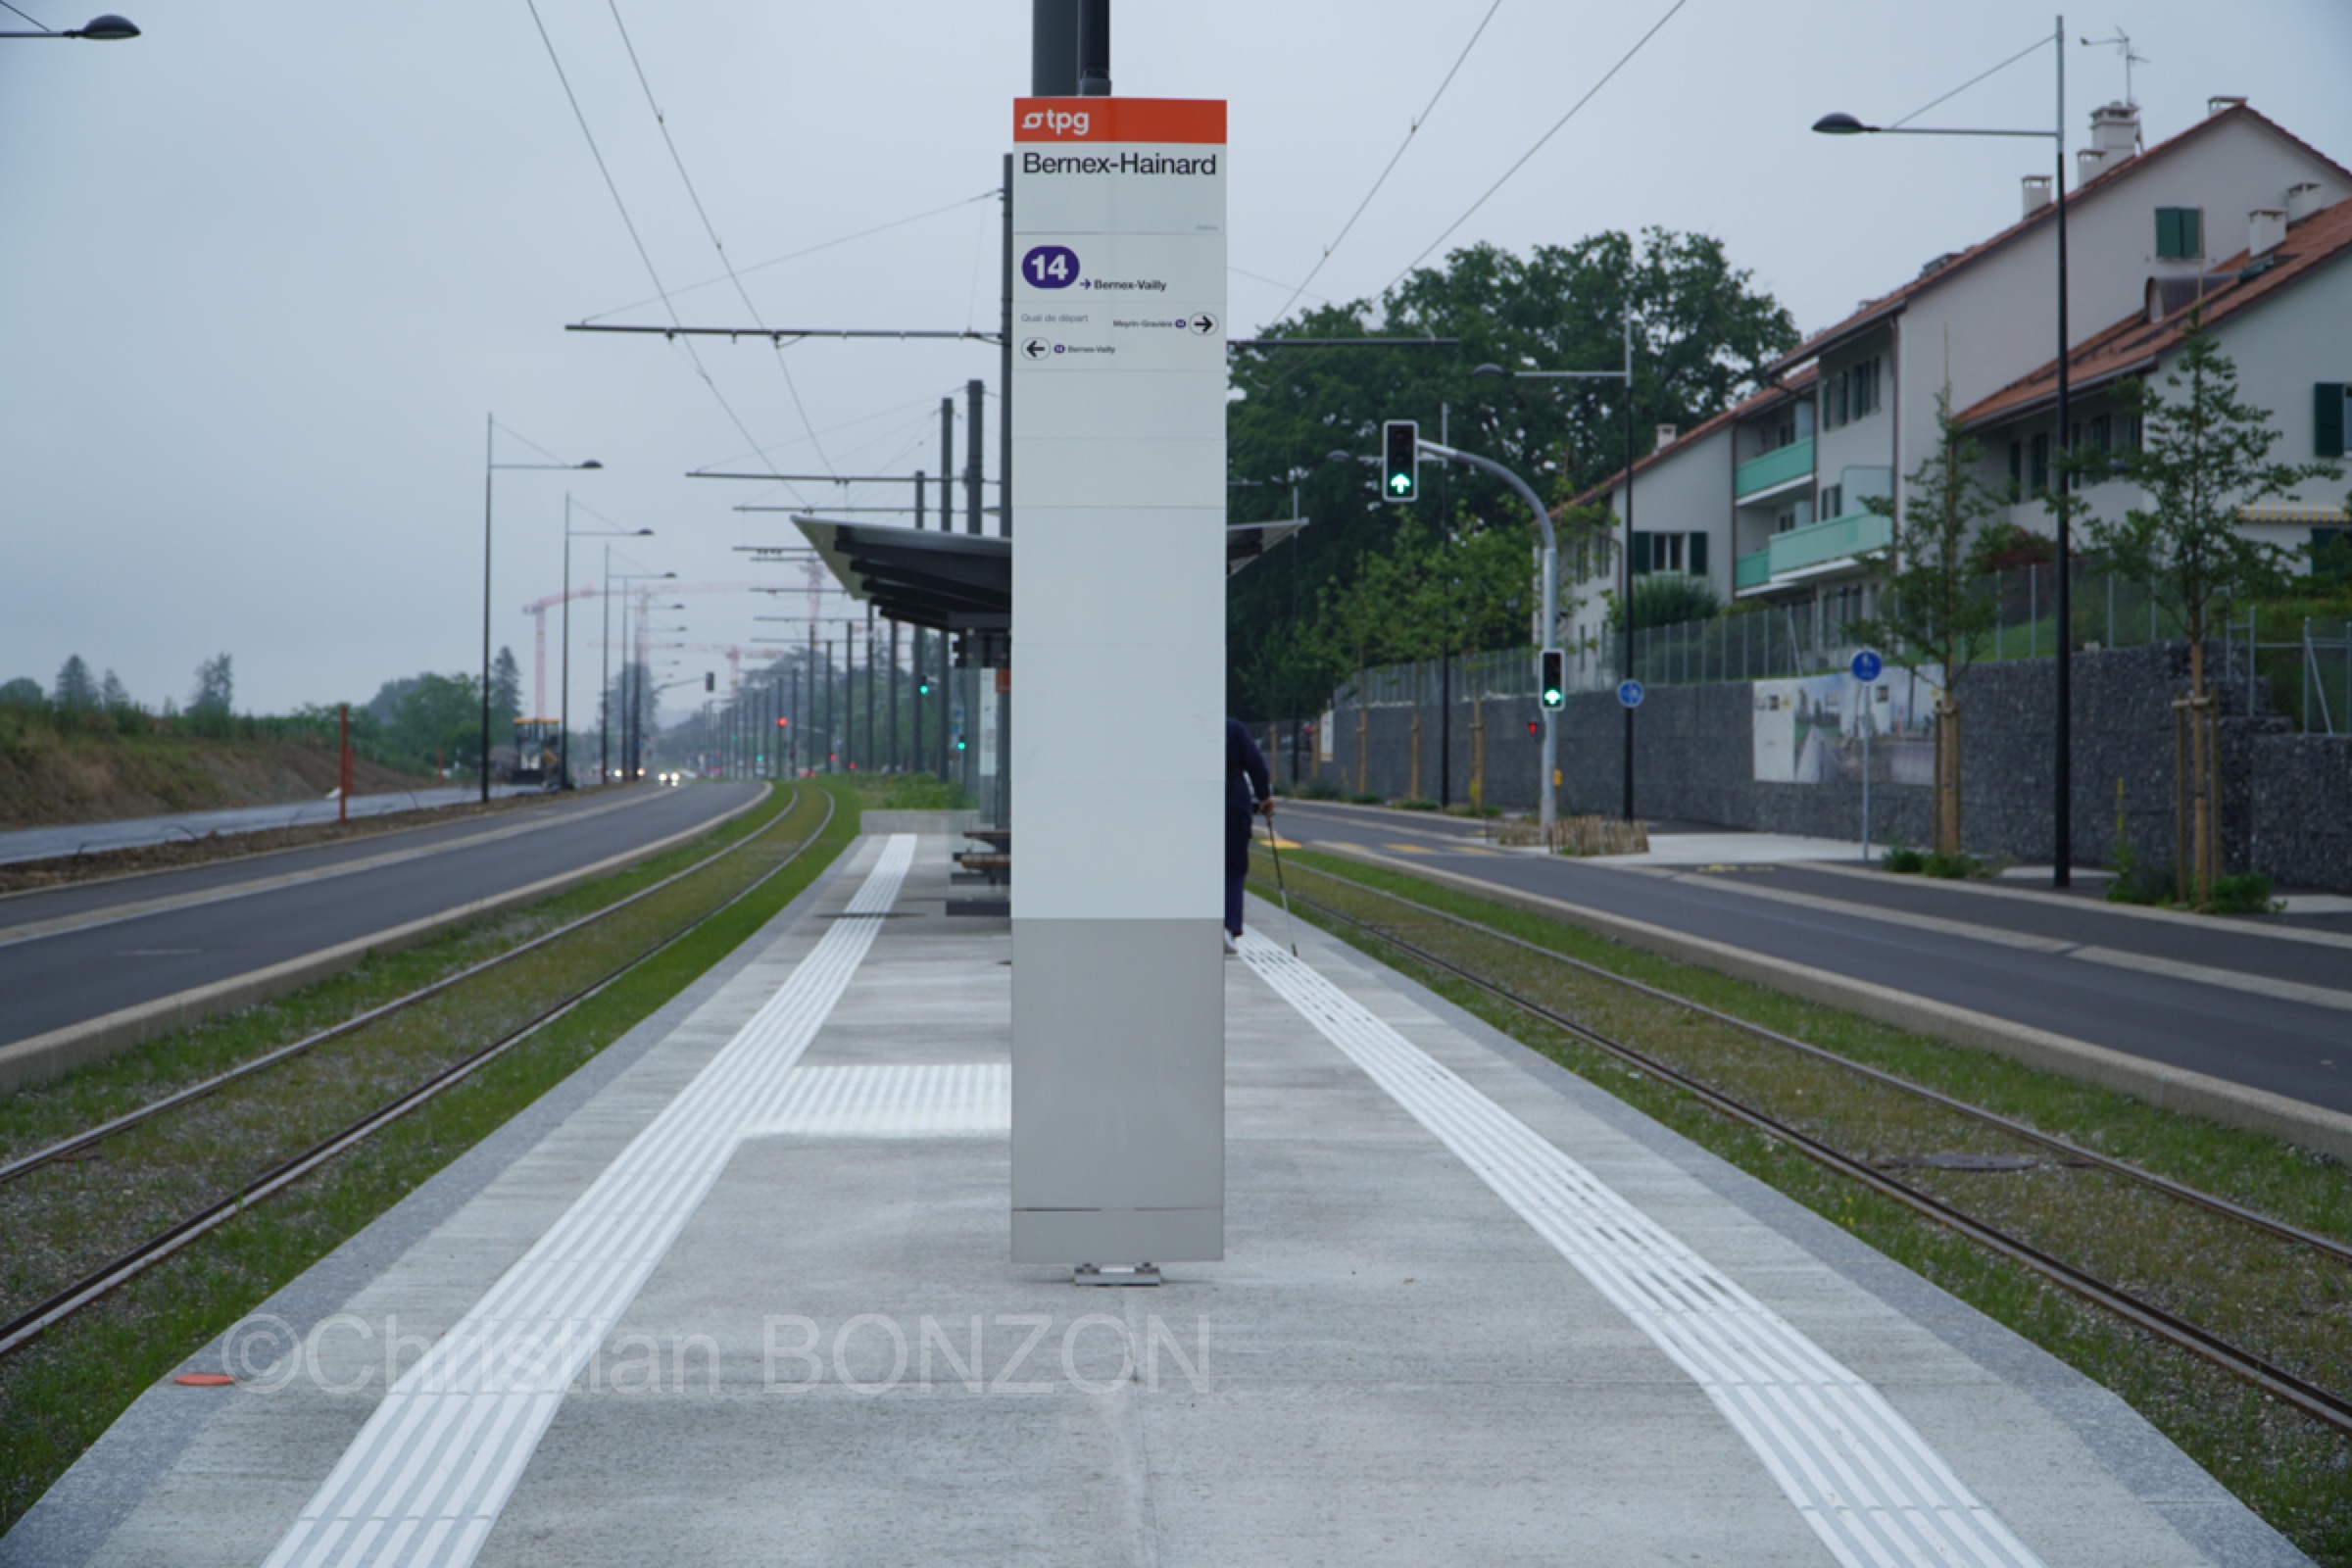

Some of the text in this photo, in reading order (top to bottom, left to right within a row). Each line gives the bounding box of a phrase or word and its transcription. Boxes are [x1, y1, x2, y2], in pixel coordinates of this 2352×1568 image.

[1047, 109, 1089, 135] tpg
[1023, 152, 1216, 175] Bernex-Hainard
[1031, 254, 1167, 292] 14 Bernex-Vailly
[1021, 313, 1089, 324] Quai de départ
